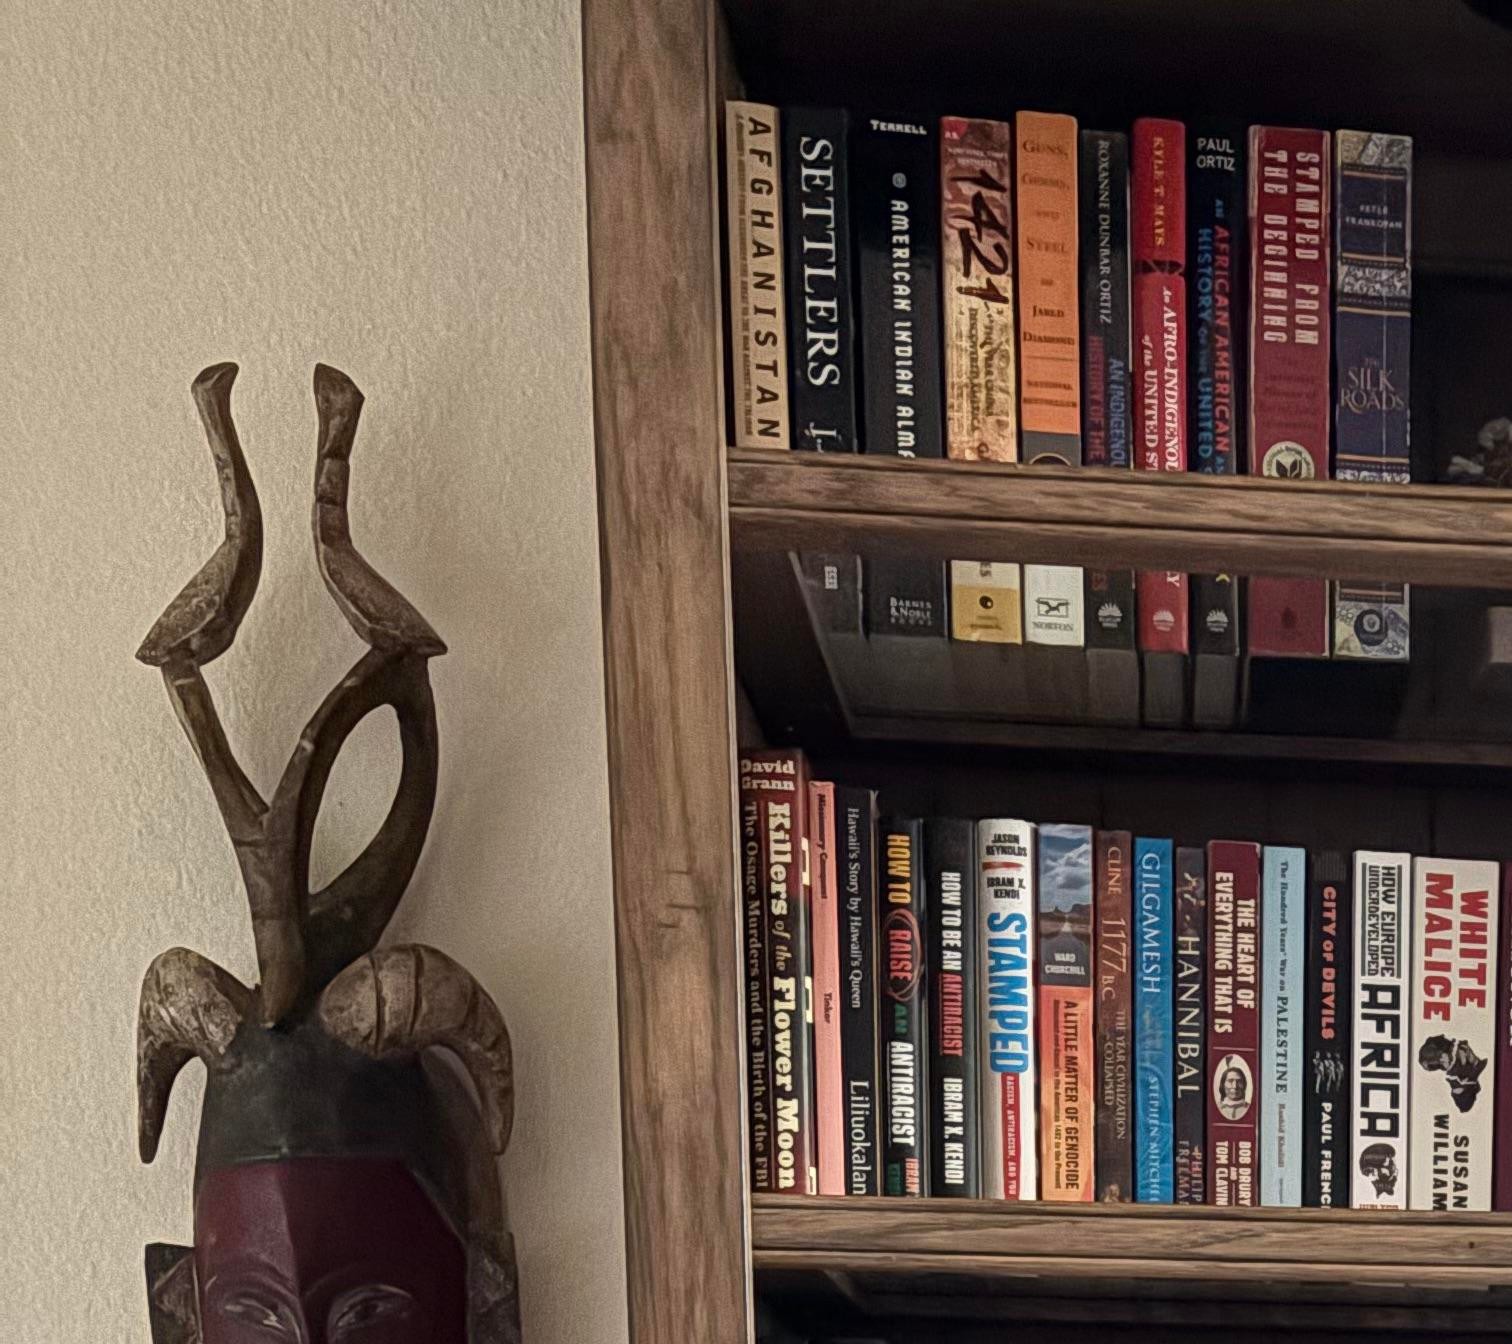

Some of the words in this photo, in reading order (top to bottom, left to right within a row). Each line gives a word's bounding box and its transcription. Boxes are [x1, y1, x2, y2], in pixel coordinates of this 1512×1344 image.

[870, 119, 927, 135] TERRELL
[1196, 154, 1236, 171] ORTIZ
[1198, 138, 1234, 154] PAUL
[1263, 149, 1288, 196] THE
[1296, 151, 1319, 259] STAMPED
[748, 117, 780, 439] AFGHANISTAN
[800, 137, 840, 387] SETTLERS
[1296, 282, 1319, 345] FROM
[769, 803, 791, 919] Killers
[942, 872, 961, 902] HOW
[773, 920, 790, 939] of
[773, 943, 790, 972] the
[942, 908, 962, 925] TO
[943, 930, 962, 948] BE
[943, 952, 962, 971] AN
[1141, 854, 1161, 994] GILGAMESH
[1423, 873, 1454, 1020] MALICE
[1458, 890, 1489, 1008] WHITE
[774, 978, 796, 1093] Flower
[939, 975, 962, 1057] ANTIRACIST
[988, 913, 1030, 1073] STAMPED
[1177, 937, 1200, 1097] HANNIBAL
[1276, 990, 1289, 1093] PALESTINE
[1359, 984, 1400, 1138] AFRICA
[774, 1098, 796, 1189] Moon
